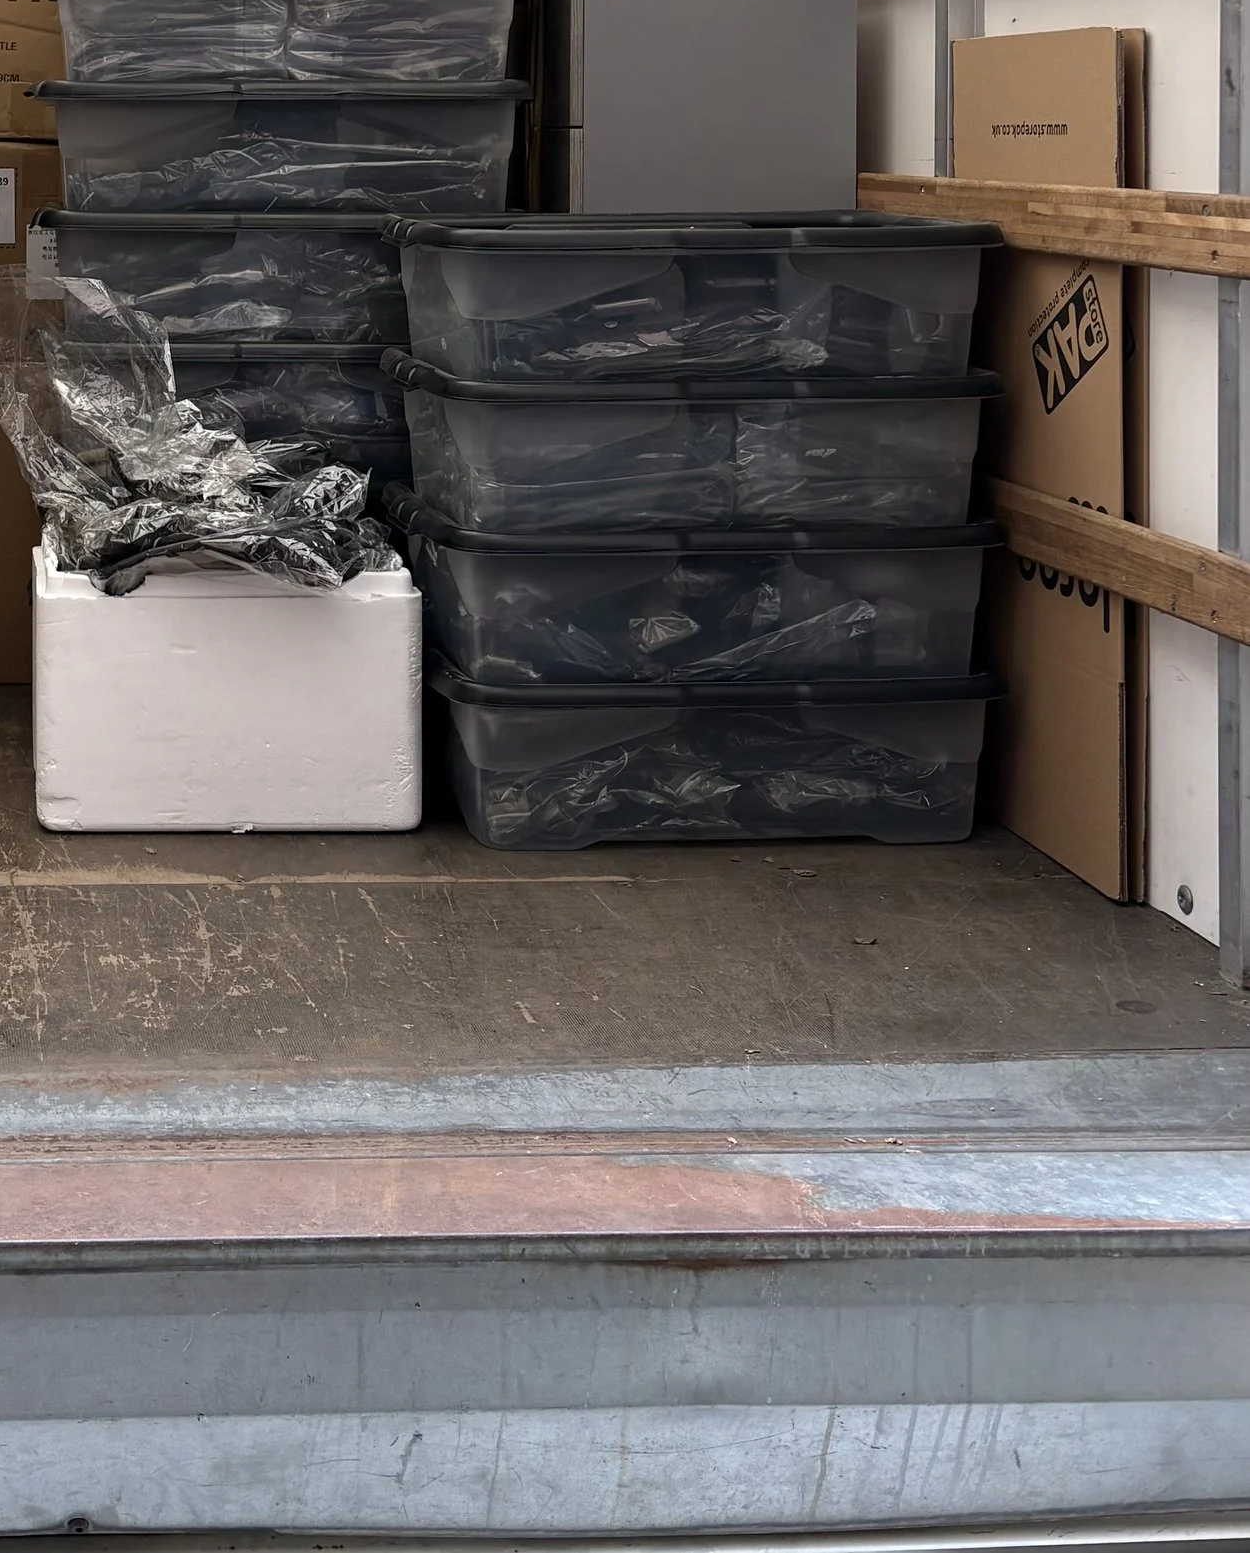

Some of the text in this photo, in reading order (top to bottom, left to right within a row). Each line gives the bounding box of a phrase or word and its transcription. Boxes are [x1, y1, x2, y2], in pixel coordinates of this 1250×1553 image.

[991, 120, 1068, 139] www.storepak.co.uk
[1027, 290, 1060, 337] protection
[1084, 287, 1104, 344] store
[1034, 280, 1107, 409] PAK
